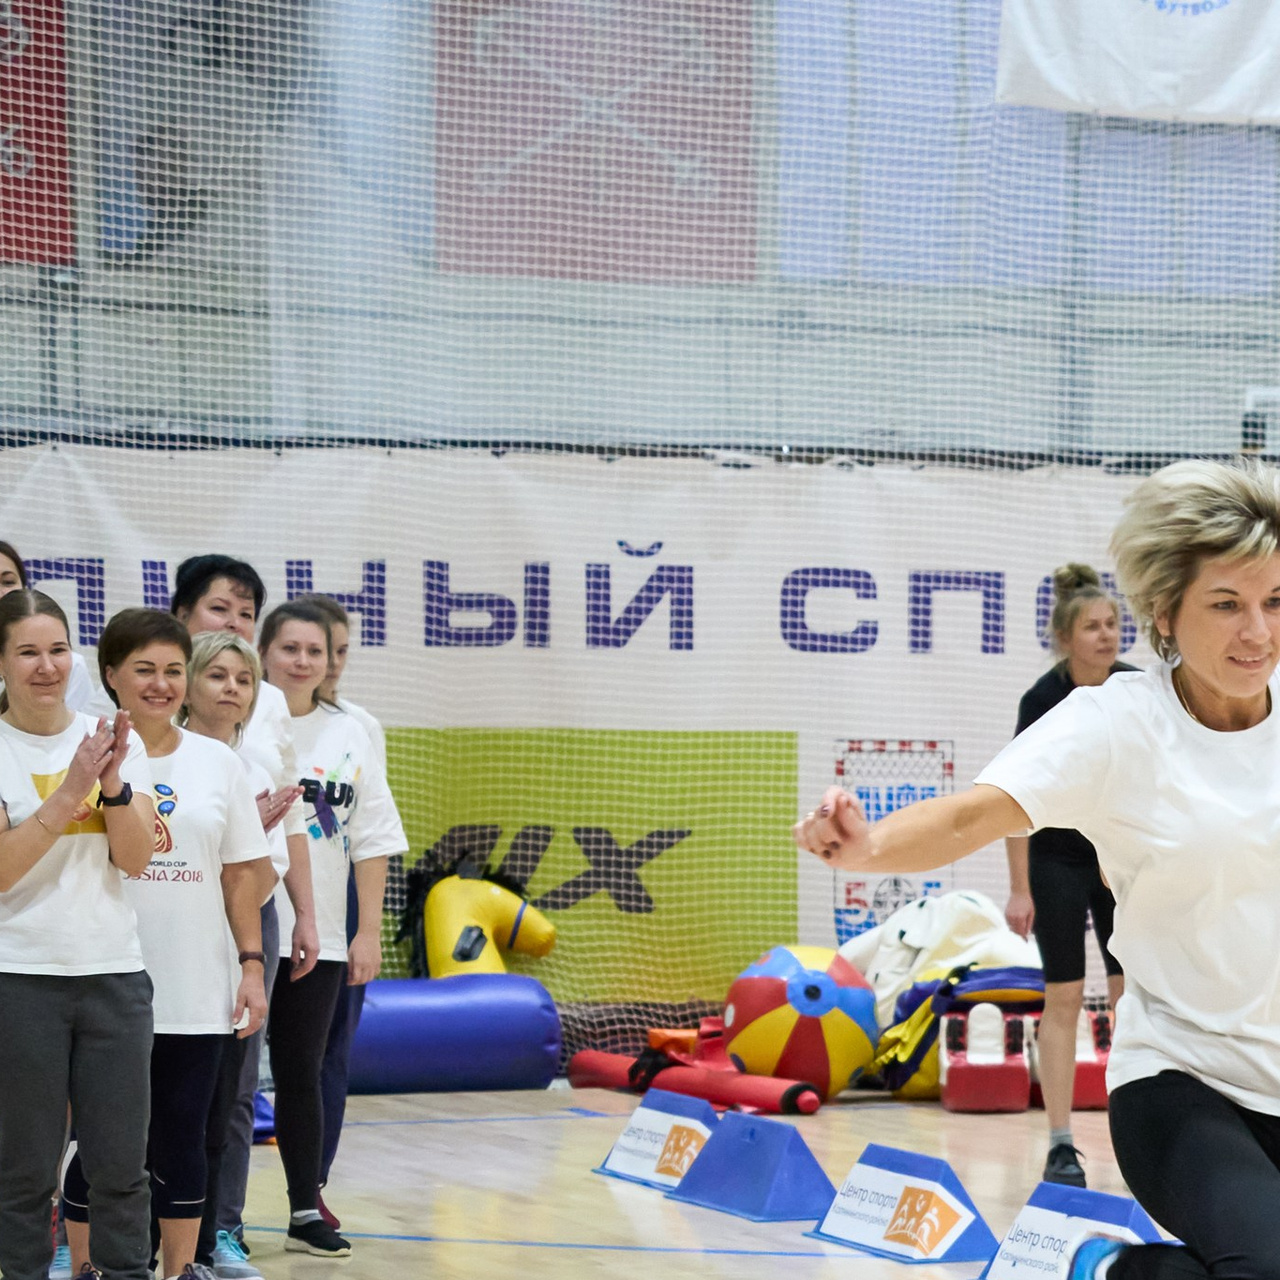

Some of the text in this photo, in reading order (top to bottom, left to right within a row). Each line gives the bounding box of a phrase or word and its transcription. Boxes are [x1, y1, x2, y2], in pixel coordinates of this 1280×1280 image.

[171, 869, 203, 882] 2018
[840, 1181, 869, 1207] Центр
[1008, 1223, 1041, 1252] Центр
